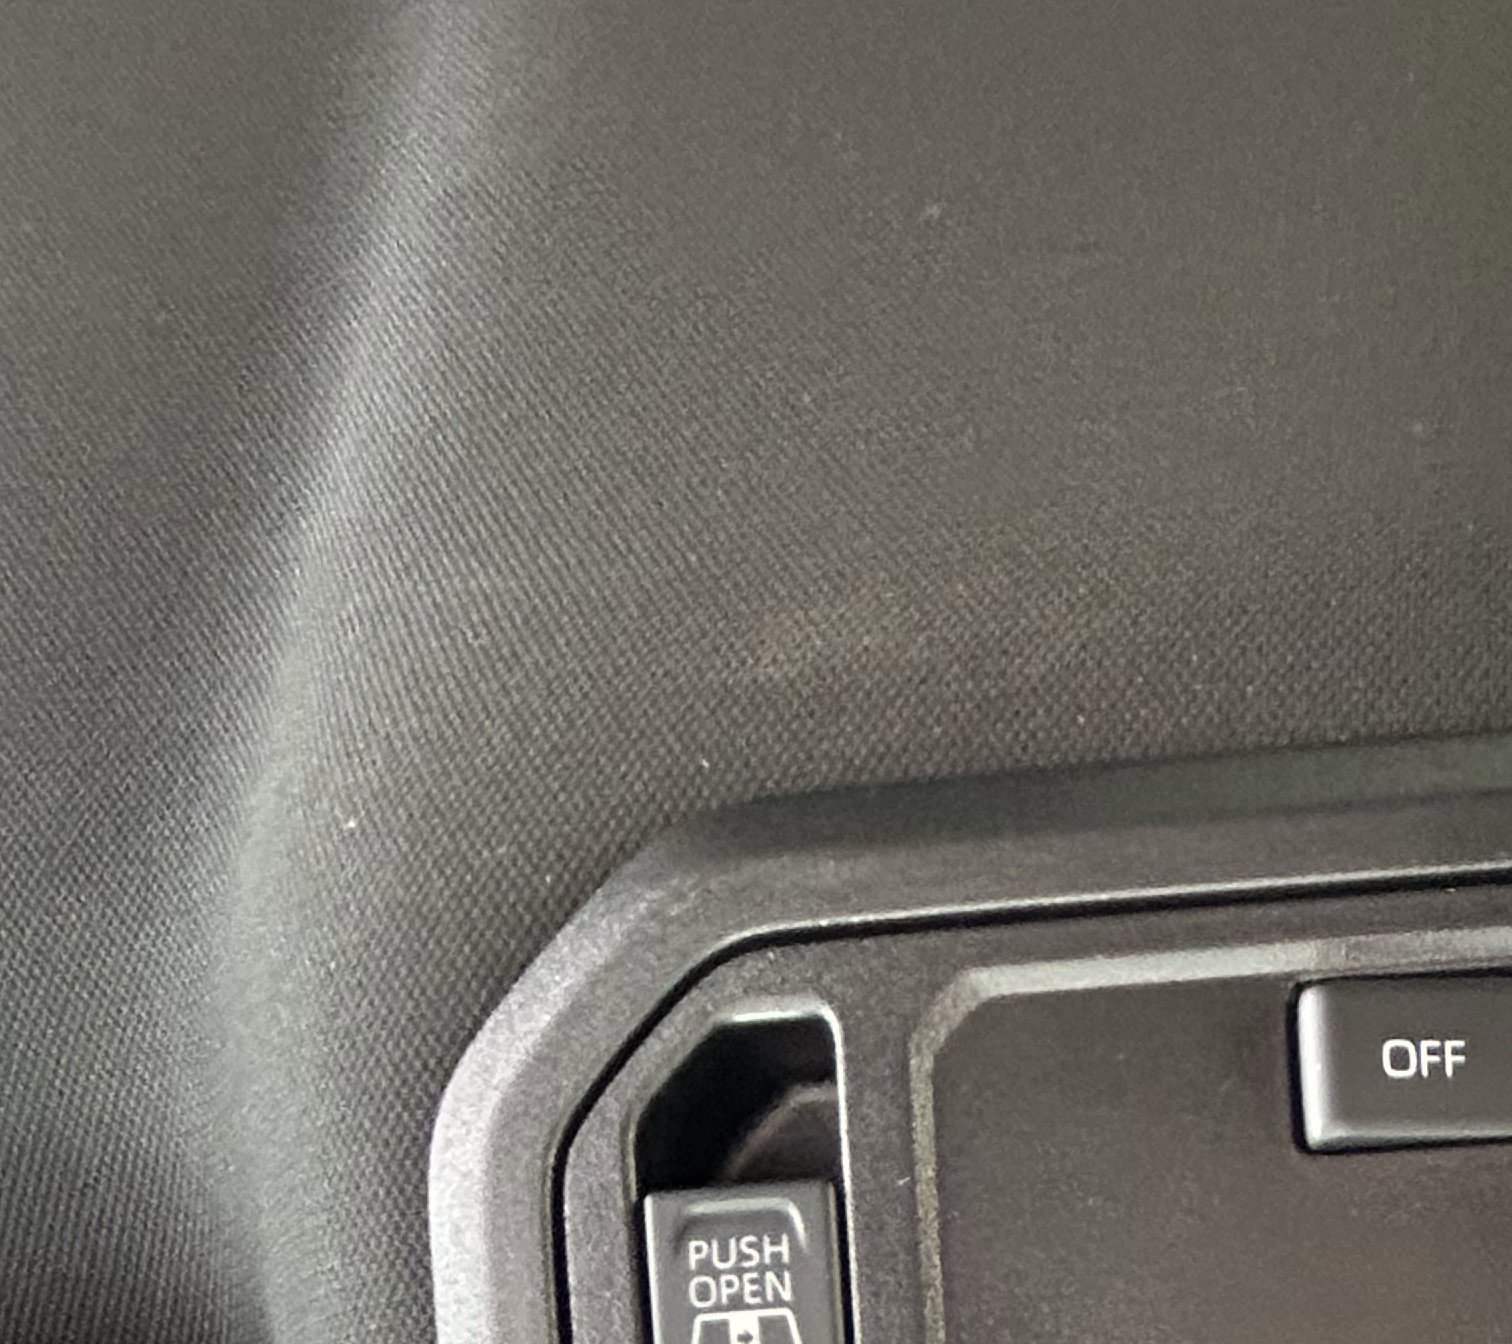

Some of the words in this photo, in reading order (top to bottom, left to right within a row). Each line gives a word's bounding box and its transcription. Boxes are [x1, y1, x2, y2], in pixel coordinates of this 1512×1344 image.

[1382, 1039, 1466, 1079] OFF
[688, 1233, 790, 1270] PUSH
[688, 1270, 793, 1308] OPEN
